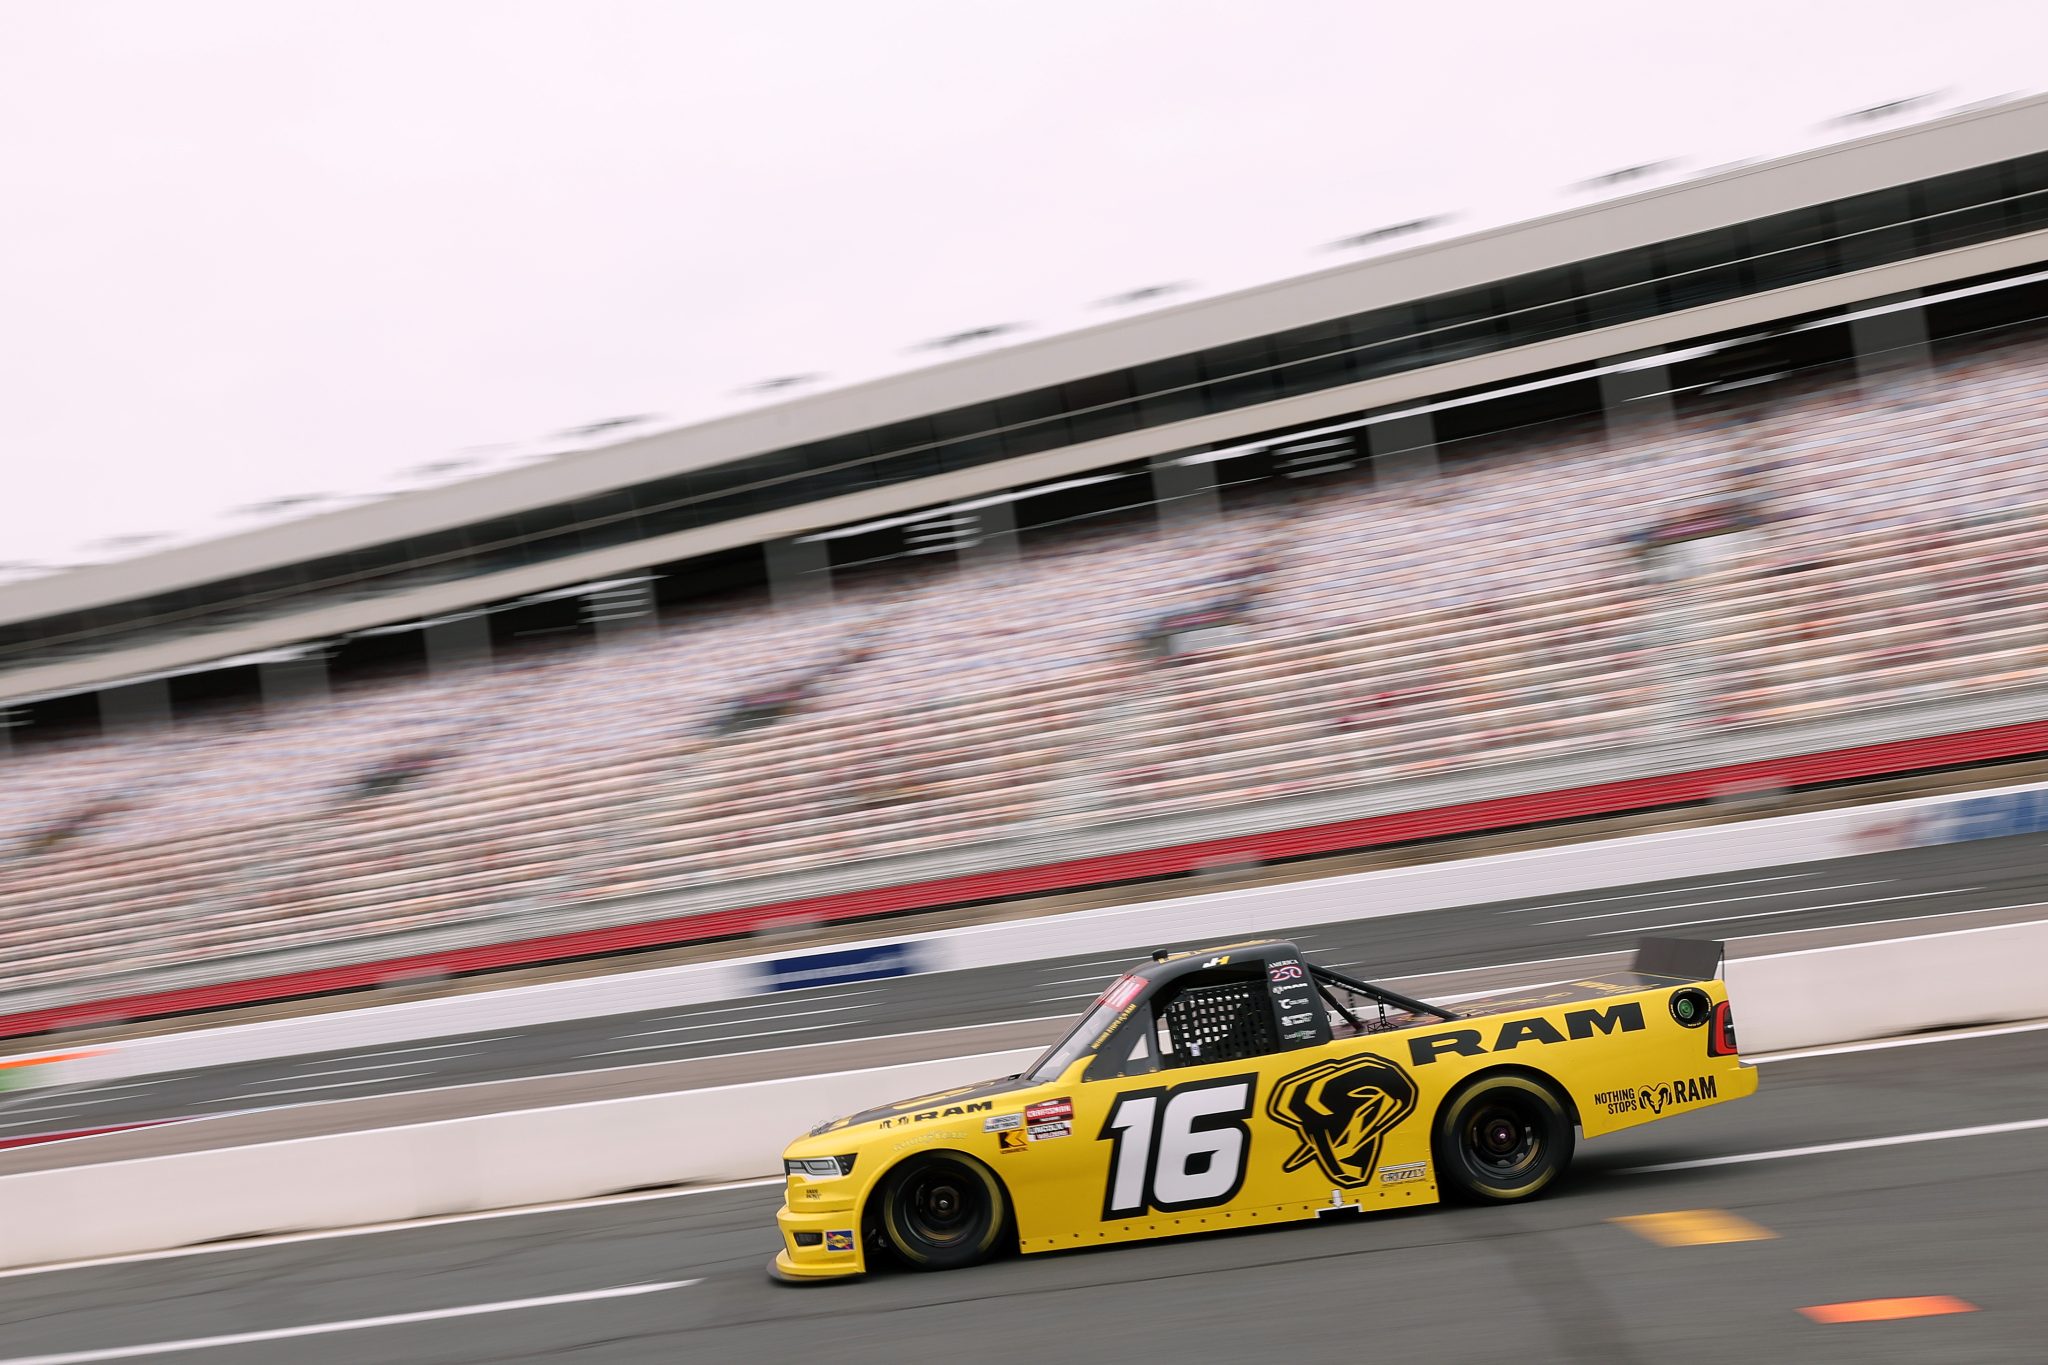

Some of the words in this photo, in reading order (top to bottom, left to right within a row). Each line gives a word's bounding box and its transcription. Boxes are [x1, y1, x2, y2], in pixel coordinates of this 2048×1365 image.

[1408, 1002, 1645, 1066] RAM
[1594, 1088, 1635, 1105] NOTHING
[1673, 1075, 1717, 1104] RAM
[914, 1101, 992, 1122] RAM
[1608, 1100, 1637, 1114] STOPS
[1106, 1078, 1254, 1216] 16
